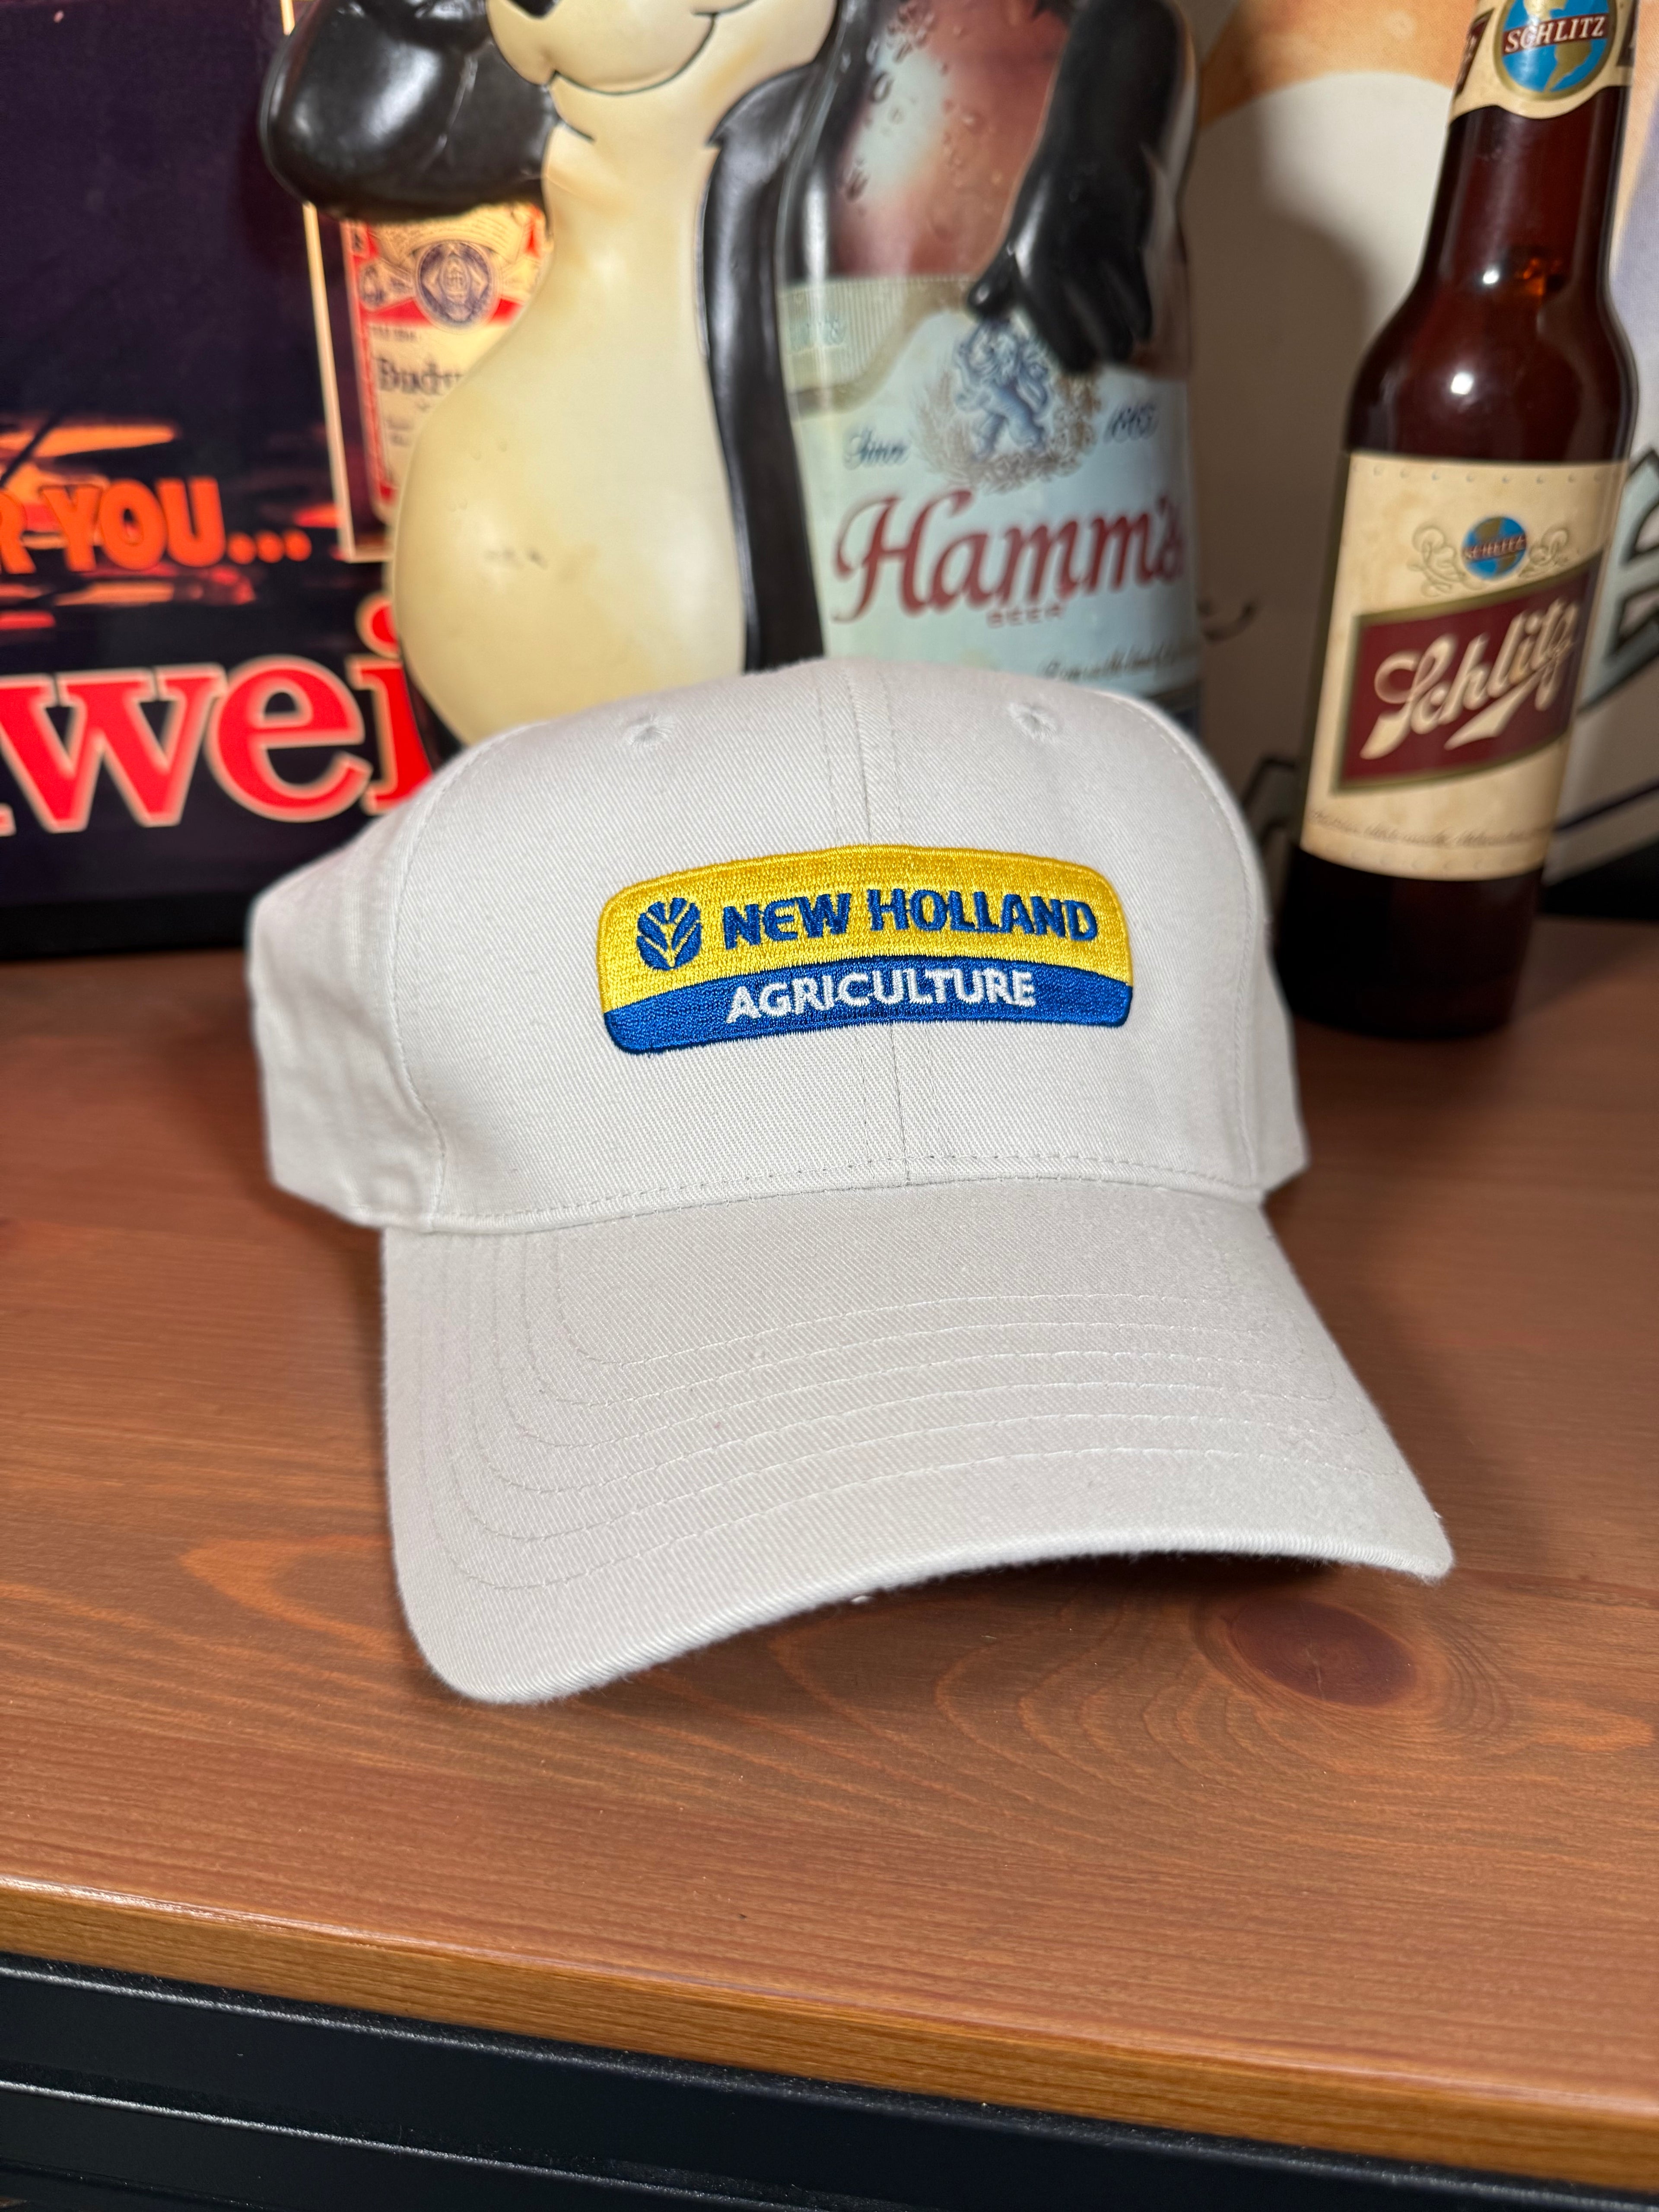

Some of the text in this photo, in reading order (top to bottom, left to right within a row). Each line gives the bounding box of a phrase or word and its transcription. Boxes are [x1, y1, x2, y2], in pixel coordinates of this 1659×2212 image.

[1504, 16, 1606, 53] SCHLITZ
[41, 475, 312, 572] YOU...
[832, 487, 1188, 624] Hamm's
[0, 593, 432, 836] wei
[1359, 597, 1579, 760] Schlitz
[722, 888, 1098, 950] NEW HOLLAND
[725, 967, 1036, 1023] AGRICULTURE
